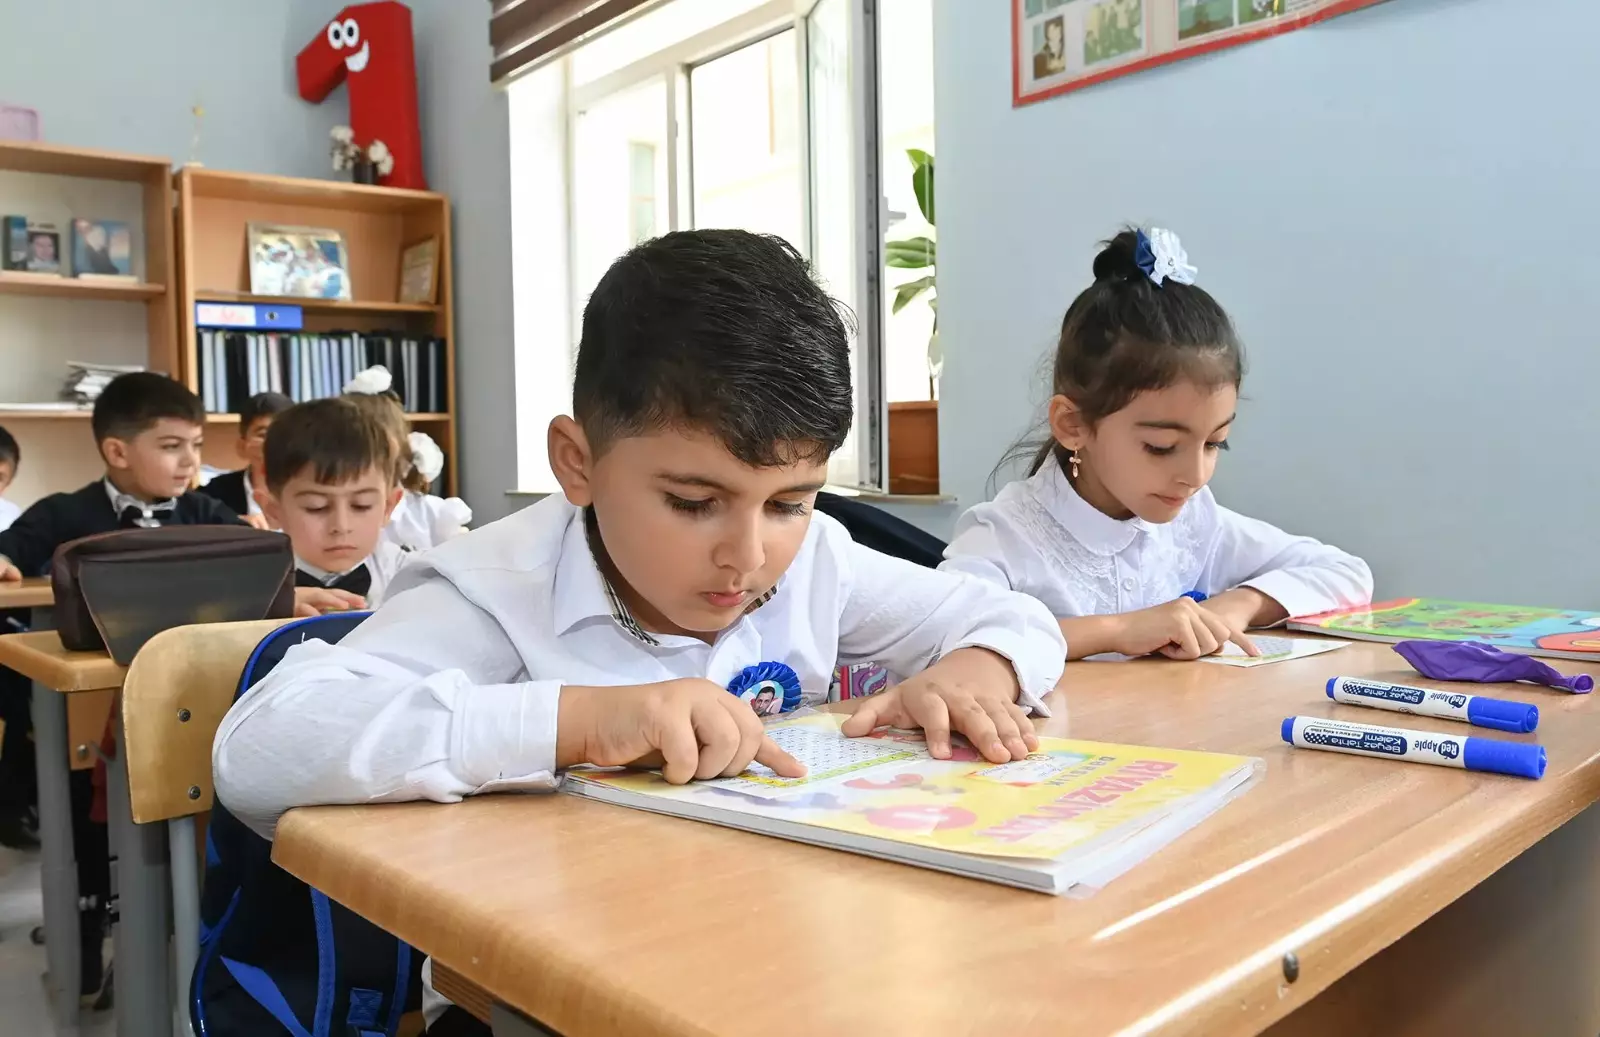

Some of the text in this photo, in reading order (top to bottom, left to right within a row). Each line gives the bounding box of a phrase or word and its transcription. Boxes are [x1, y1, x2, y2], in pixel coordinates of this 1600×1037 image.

[1363, 688, 1419, 703] Beyaz Tahta
[1391, 686, 1421, 695] Kalemi
[1429, 692, 1467, 705] Red Apple
[1331, 737, 1401, 753] Beyaz Tahta
[1364, 734, 1402, 744] Kalemi
[1414, 740, 1458, 755] Red Apple
